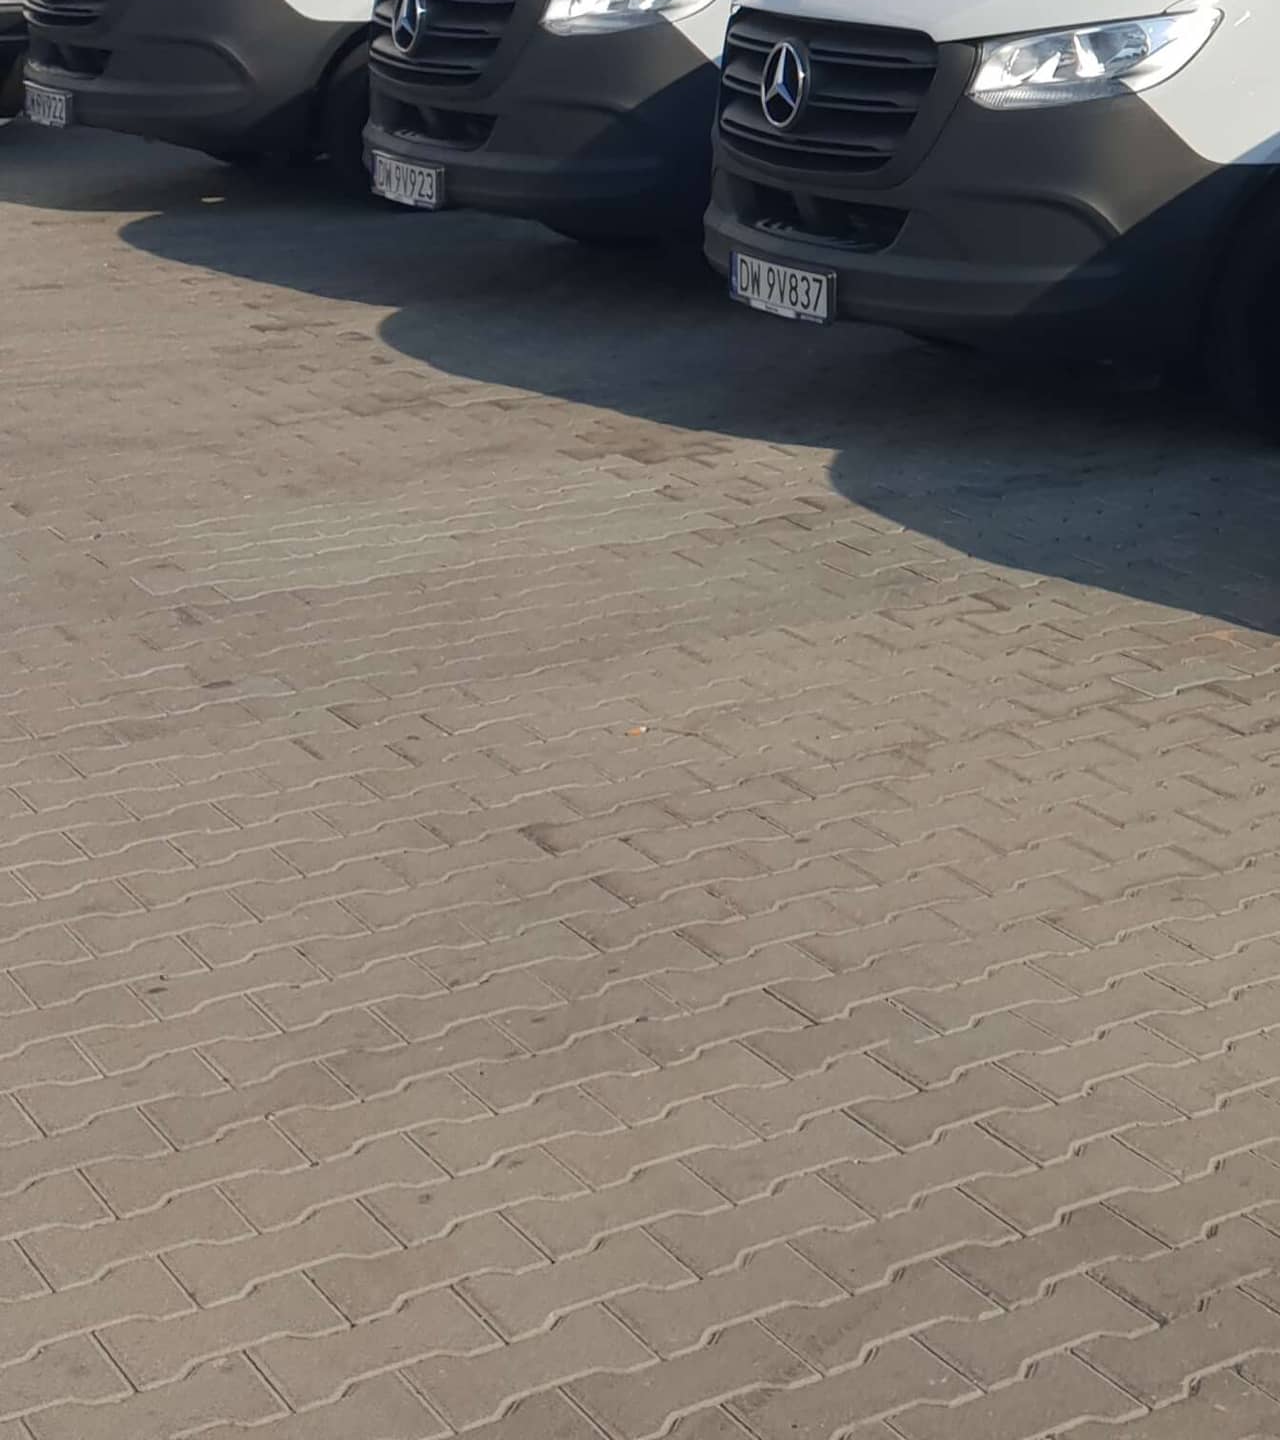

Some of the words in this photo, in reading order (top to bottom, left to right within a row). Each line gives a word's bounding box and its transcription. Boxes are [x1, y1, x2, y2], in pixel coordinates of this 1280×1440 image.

[395, 165, 434, 201] 9V923
[740, 258, 761, 297] DW
[767, 266, 823, 312] 9V837
